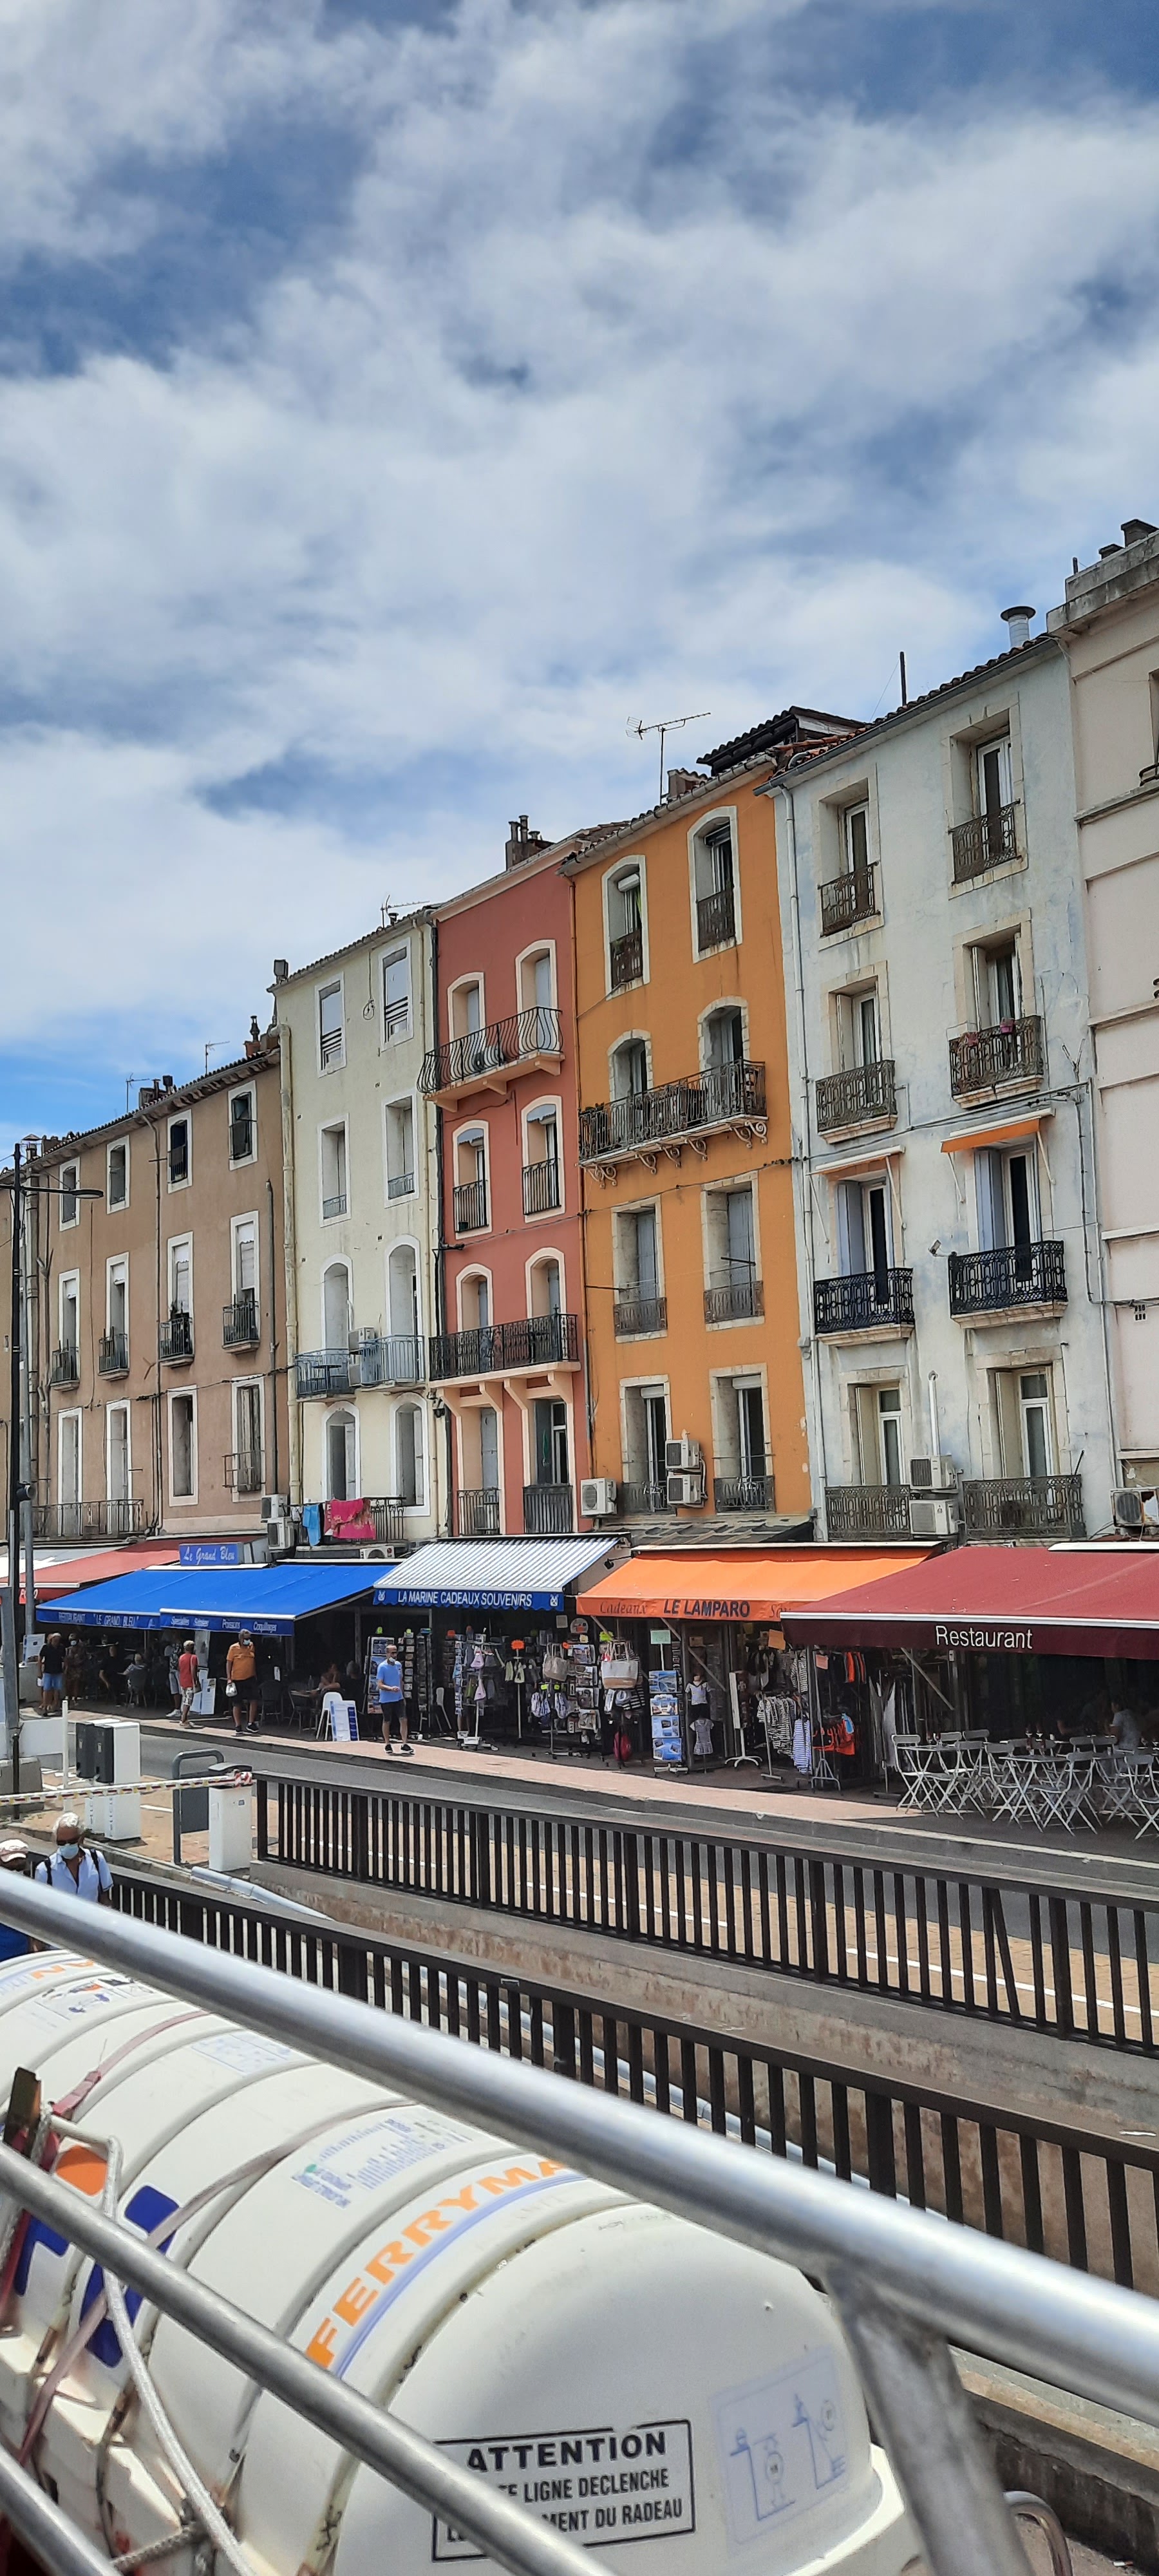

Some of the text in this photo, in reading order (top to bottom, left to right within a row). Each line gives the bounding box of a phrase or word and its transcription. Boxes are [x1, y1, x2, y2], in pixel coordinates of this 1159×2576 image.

[183, 1546, 235, 1566] Le Grand Bleu
[397, 1591, 532, 1607] LA MARINE CADEAUX SOUVENIRS
[663, 1599, 679, 1615] LE
[683, 1600, 751, 1618] LAMPARO
[936, 1625, 1033, 1649] Restaurant
[305, 2159, 569, 2369] FERRYMA
[467, 2430, 666, 2473] ATTENTION
[523, 2478, 573, 2503] LIGNE
[578, 2468, 670, 2497] DECLENCHE
[595, 2505, 617, 2528] DU
[621, 2497, 683, 2524] RADEAU
